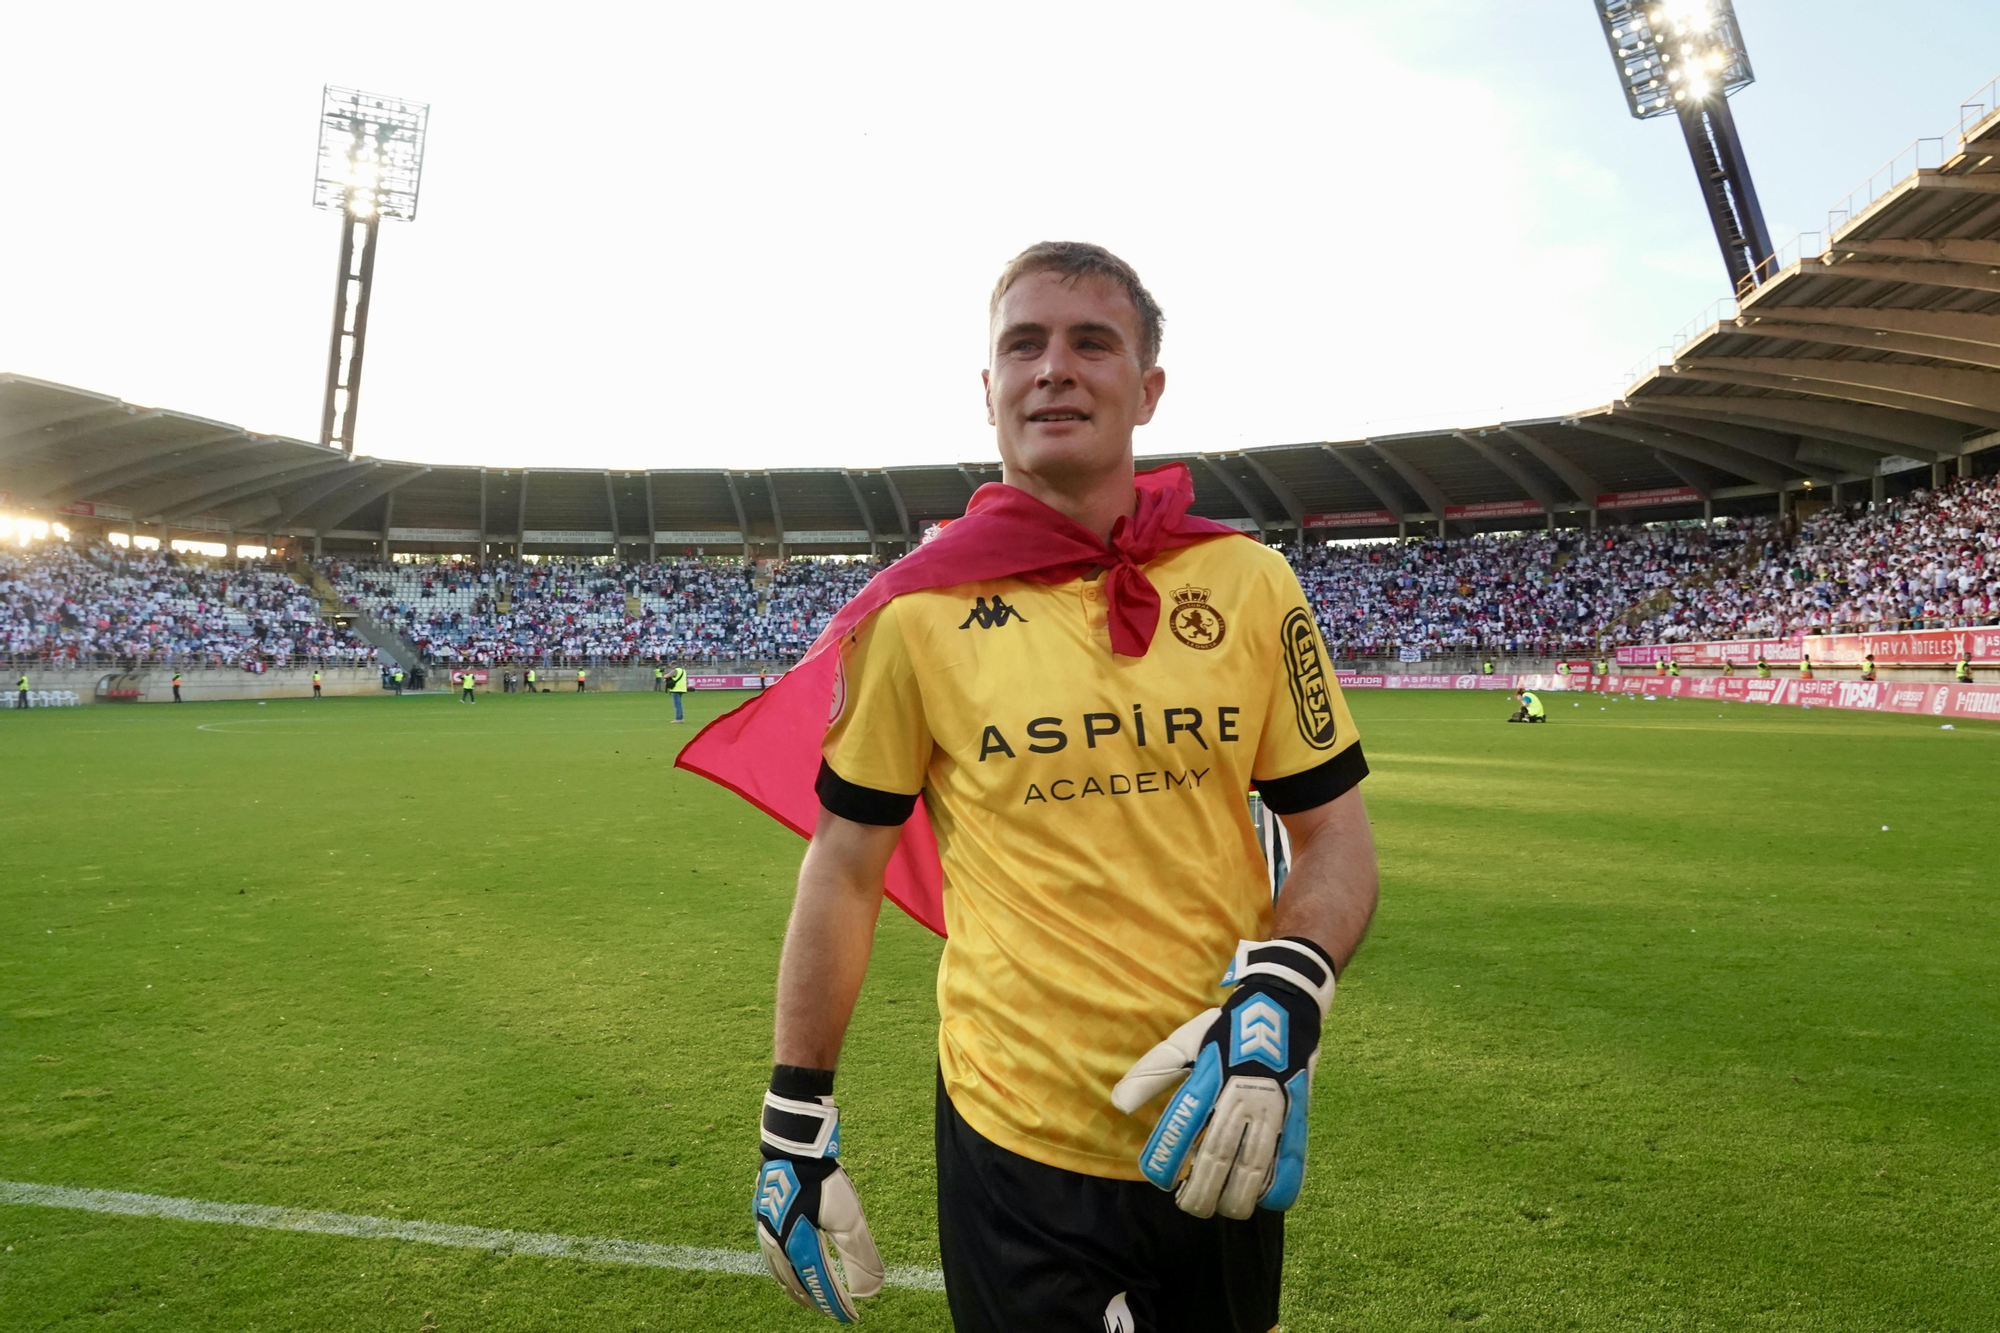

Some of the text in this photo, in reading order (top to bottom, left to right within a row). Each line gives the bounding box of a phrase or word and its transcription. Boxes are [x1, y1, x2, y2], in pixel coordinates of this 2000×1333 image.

[1911, 640, 1953, 655] HOTELES
[1747, 679, 1776, 690] GRUAS
[1799, 681, 1833, 696] ASPIRE
[1748, 690, 1770, 701] JUAN
[1838, 682, 1879, 708] TIPSA
[978, 703, 1241, 763] ASPIRE
[1023, 767, 1210, 806] ACADEMY
[1148, 1093, 1200, 1174] TWOFIVE
